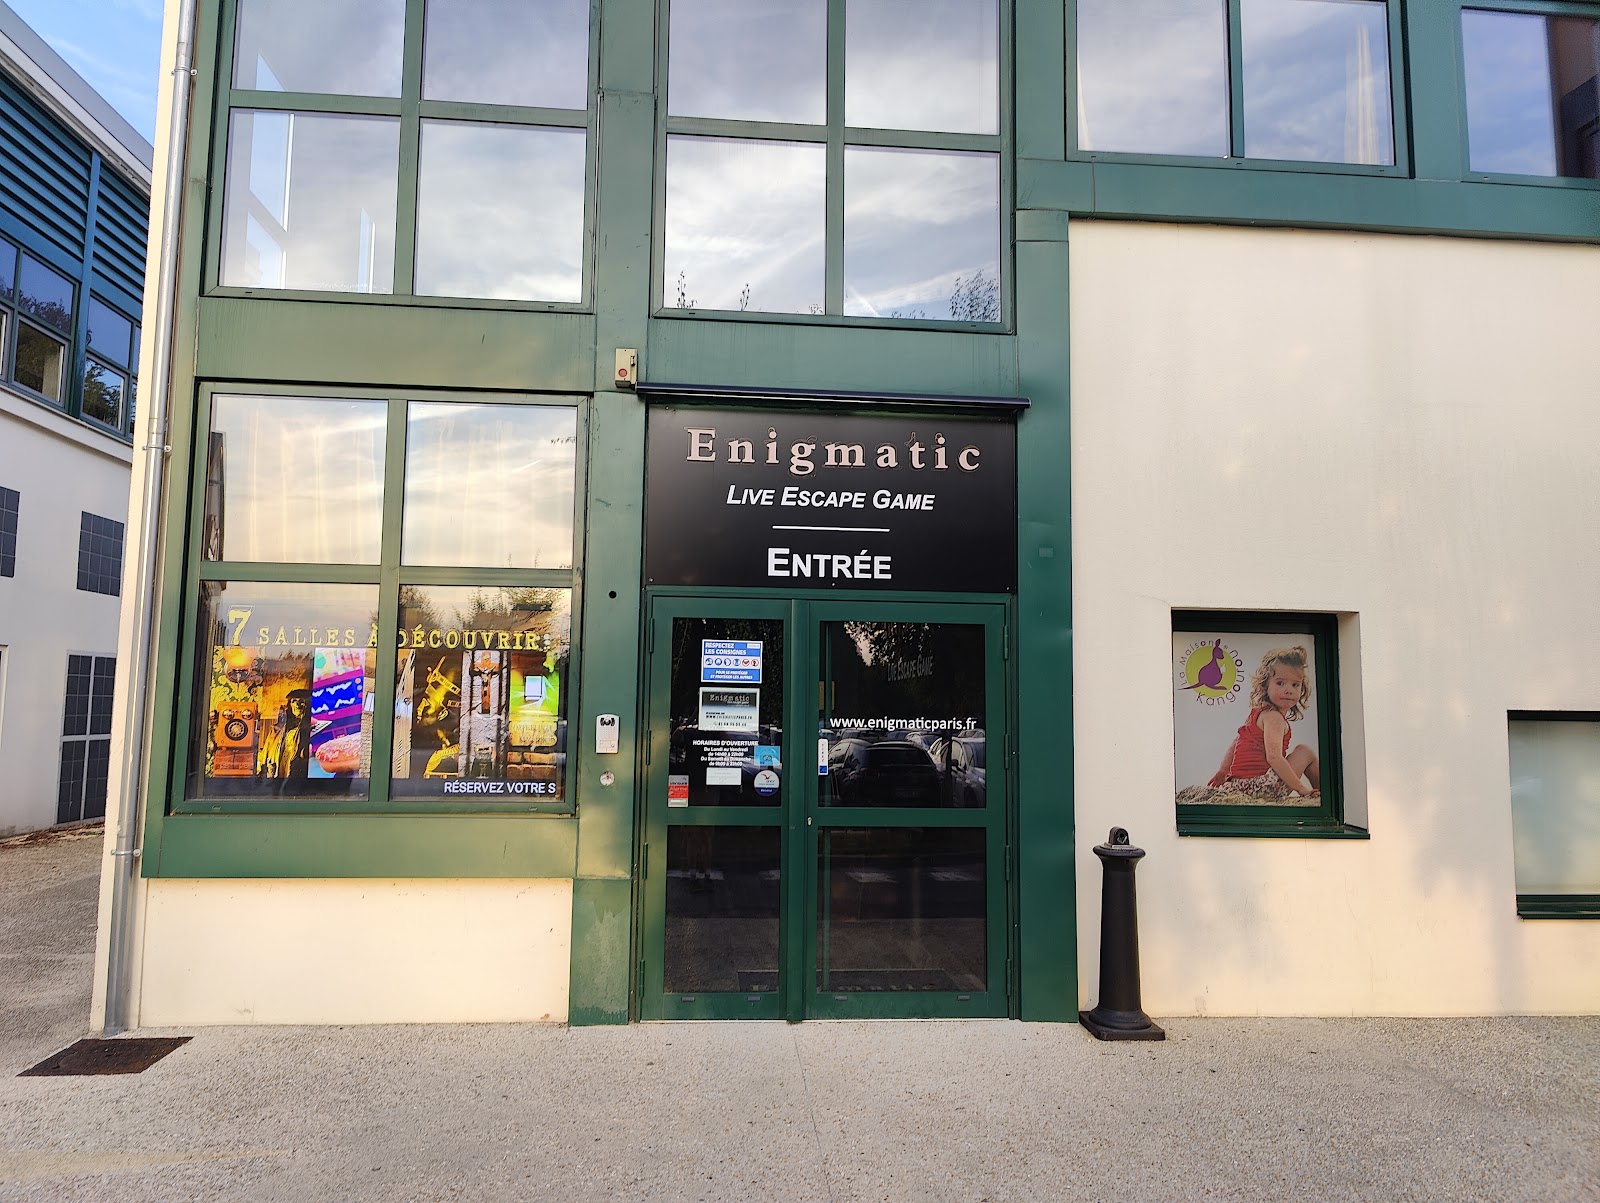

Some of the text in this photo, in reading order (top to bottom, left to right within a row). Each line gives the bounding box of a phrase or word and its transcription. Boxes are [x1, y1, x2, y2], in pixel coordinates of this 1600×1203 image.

[684, 426, 981, 476] Enigmatic
[767, 547, 892, 579] ENTRÉE
[228, 605, 255, 646] 7
[257, 625, 356, 647] SALLES
[1179, 639, 1214, 666] Maison
[1196, 649, 1245, 706] Kangourou
[829, 716, 977, 732] www.enigmaticparis.fr
[443, 779, 556, 794] RÉSERVEZ VOTRE S
